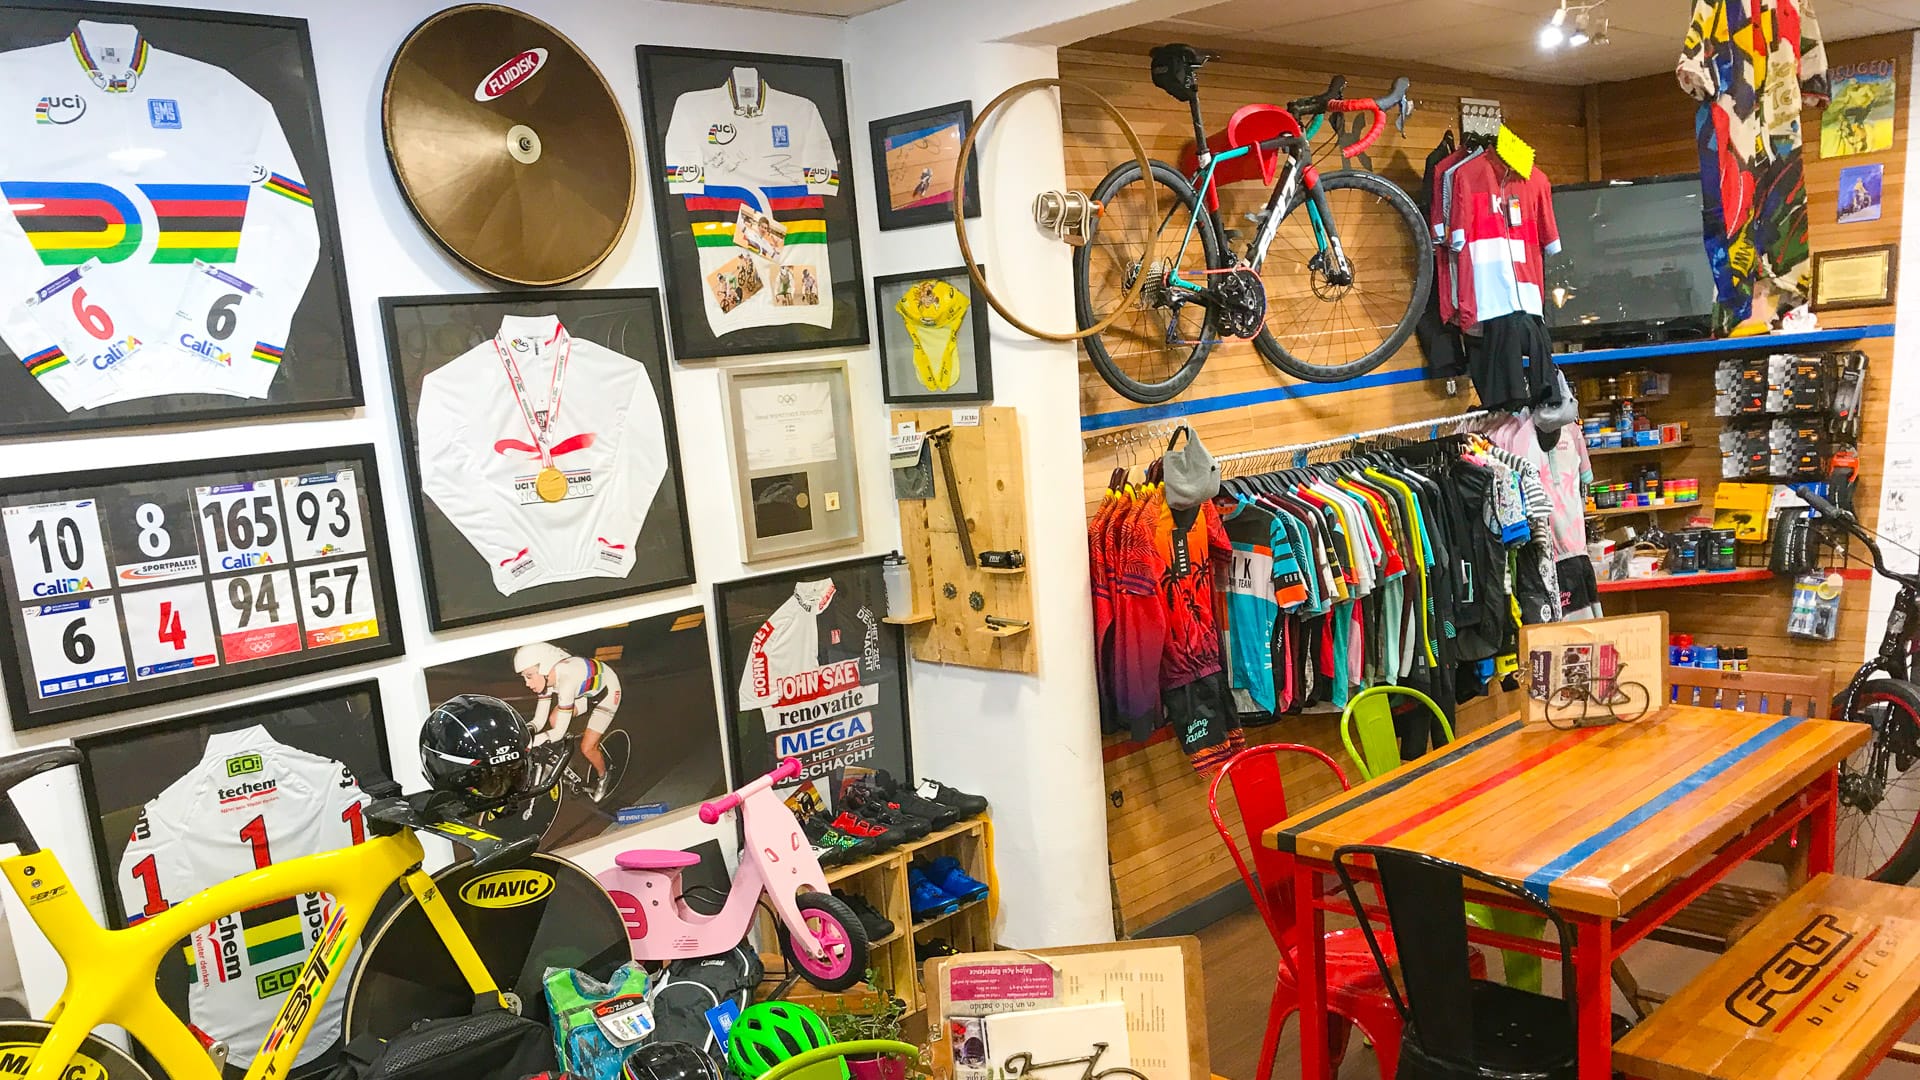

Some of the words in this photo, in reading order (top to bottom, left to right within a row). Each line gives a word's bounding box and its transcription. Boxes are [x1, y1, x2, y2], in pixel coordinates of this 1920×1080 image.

[488, 54, 536, 93] FLUIDISK
[72, 287, 114, 340] 6
[206, 294, 242, 340] 6
[93, 335, 143, 371] CaliDA
[180, 333, 232, 367] CaliDA
[515, 482, 528, 490] UCI
[568, 484, 593, 496] CUP
[136, 503, 170, 557] 8
[202, 496, 277, 552] 165
[296, 488, 350, 542] 93
[28, 517, 84, 574] 10
[222, 552, 273, 570] CaliDA
[142, 559, 196, 572] SPORTPALEIS
[34, 577, 94, 597] CaliDA
[228, 574, 280, 628] 94
[310, 566, 358, 618] 57
[62, 617, 95, 664] 6
[159, 602, 186, 650] 4
[43, 670, 127, 696] BELAZ
[753, 657, 767, 696] JOHN
[776, 670, 818, 700] JOHN
[779, 690, 864, 726] renovatie
[782, 717, 866, 756] MEGA
[812, 747, 837, 762] HET
[846, 736, 875, 752] ZELF
[230, 757, 260, 774] GO!
[489, 751, 520, 765] GIRO
[218, 779, 276, 800] techem
[240, 814, 272, 870] 1
[132, 854, 170, 916] 1
[476, 878, 539, 900] MAVIC
[969, 966, 1000, 976] Experience
[1725, 914, 1854, 1028] FELT
[1806, 938, 1899, 1027] bicycles
[970, 1002, 992, 1014] batido
